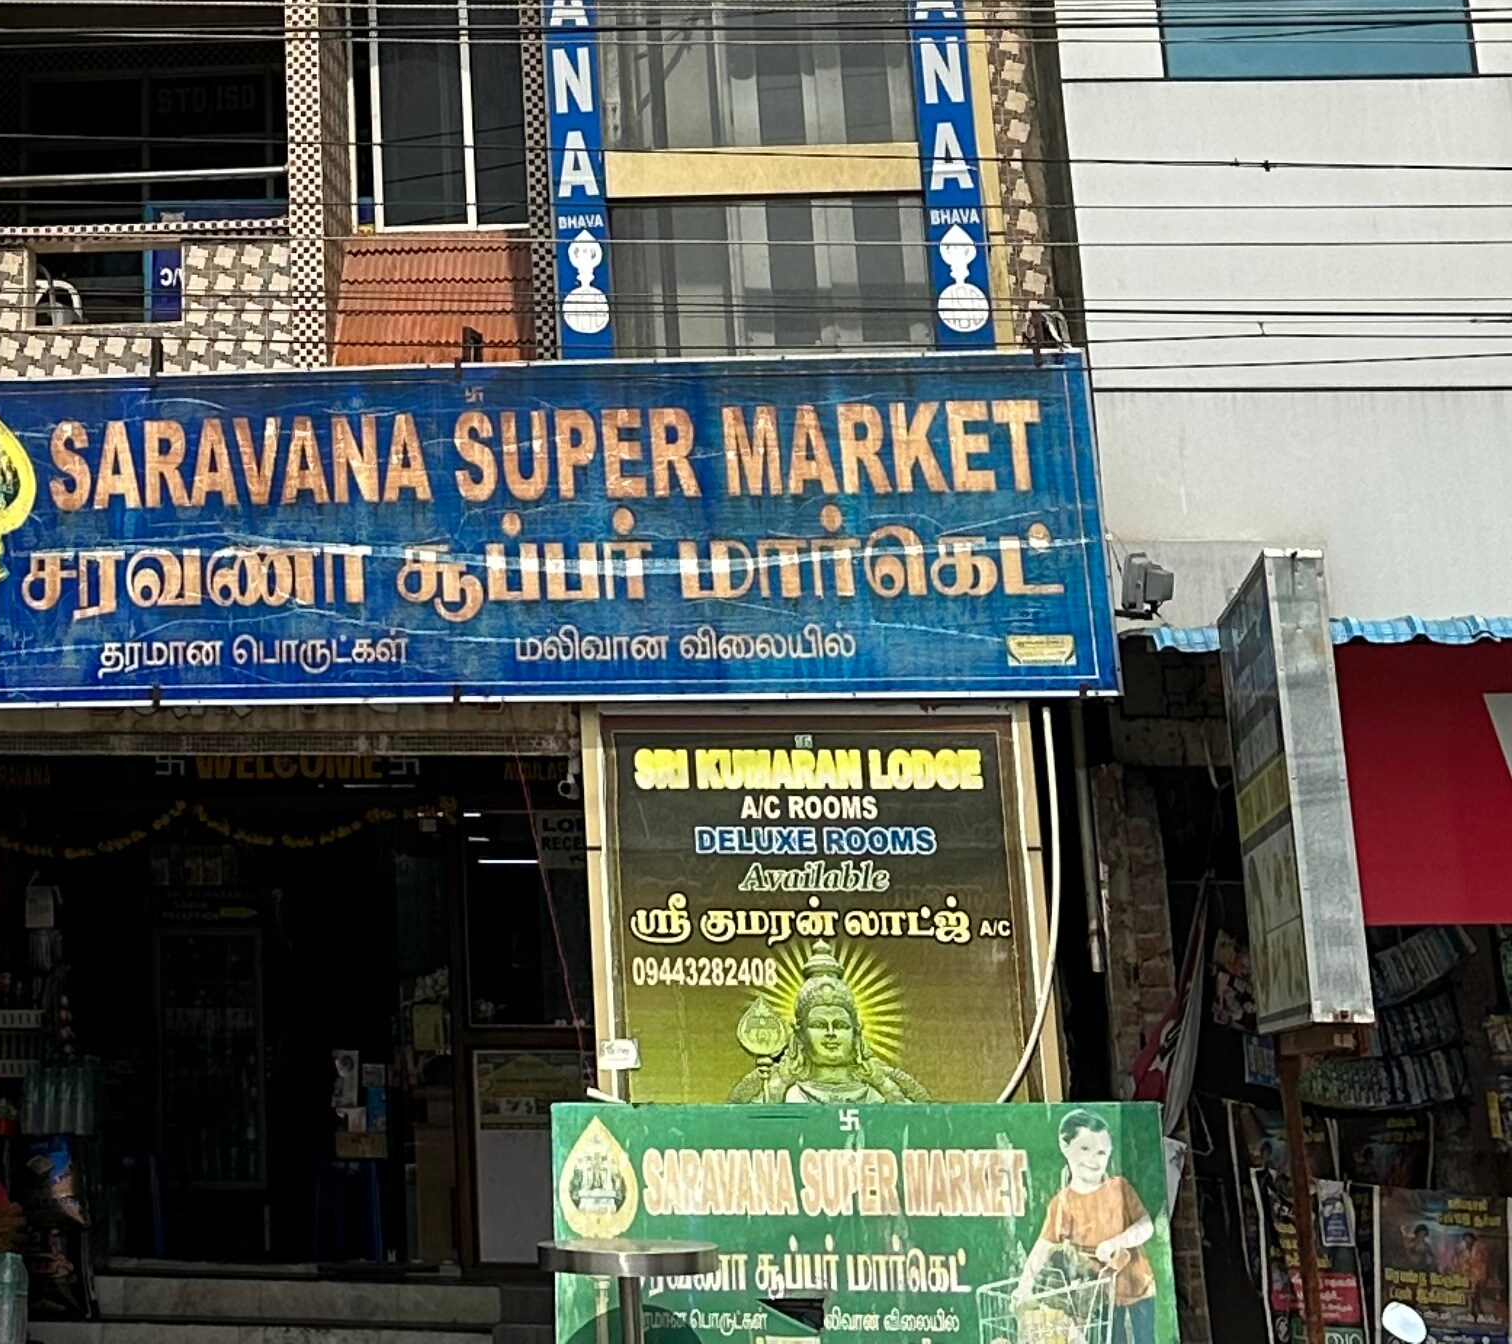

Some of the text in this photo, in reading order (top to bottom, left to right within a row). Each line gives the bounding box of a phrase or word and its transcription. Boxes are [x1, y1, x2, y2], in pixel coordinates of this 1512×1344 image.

[558, 214, 604, 230] BHAVA
[930, 210, 980, 226] BHAVA
[49, 399, 1040, 511] SARAVANA SUPER MARKET
[20, 546, 372, 622] சரவணா
[98, 636, 221, 678] தரமான
[515, 623, 668, 662] மலிவான
[679, 621, 857, 661] விலையில்
[634, 749, 983, 790] SRI KUMARAN LODGE
[741, 795, 878, 820] A/C ROOMS
[695, 826, 937, 855] DELUXE ROOMS
[738, 860, 890, 893] Available
[699, 896, 838, 946] குமரன்
[843, 896, 971, 944] லாட்ஜ்
[979, 920, 1012, 937] A/C
[633, 957, 778, 987] 09443282408
[643, 1148, 798, 1217] SARAVANA
[801, 1148, 898, 1217] SUPER
